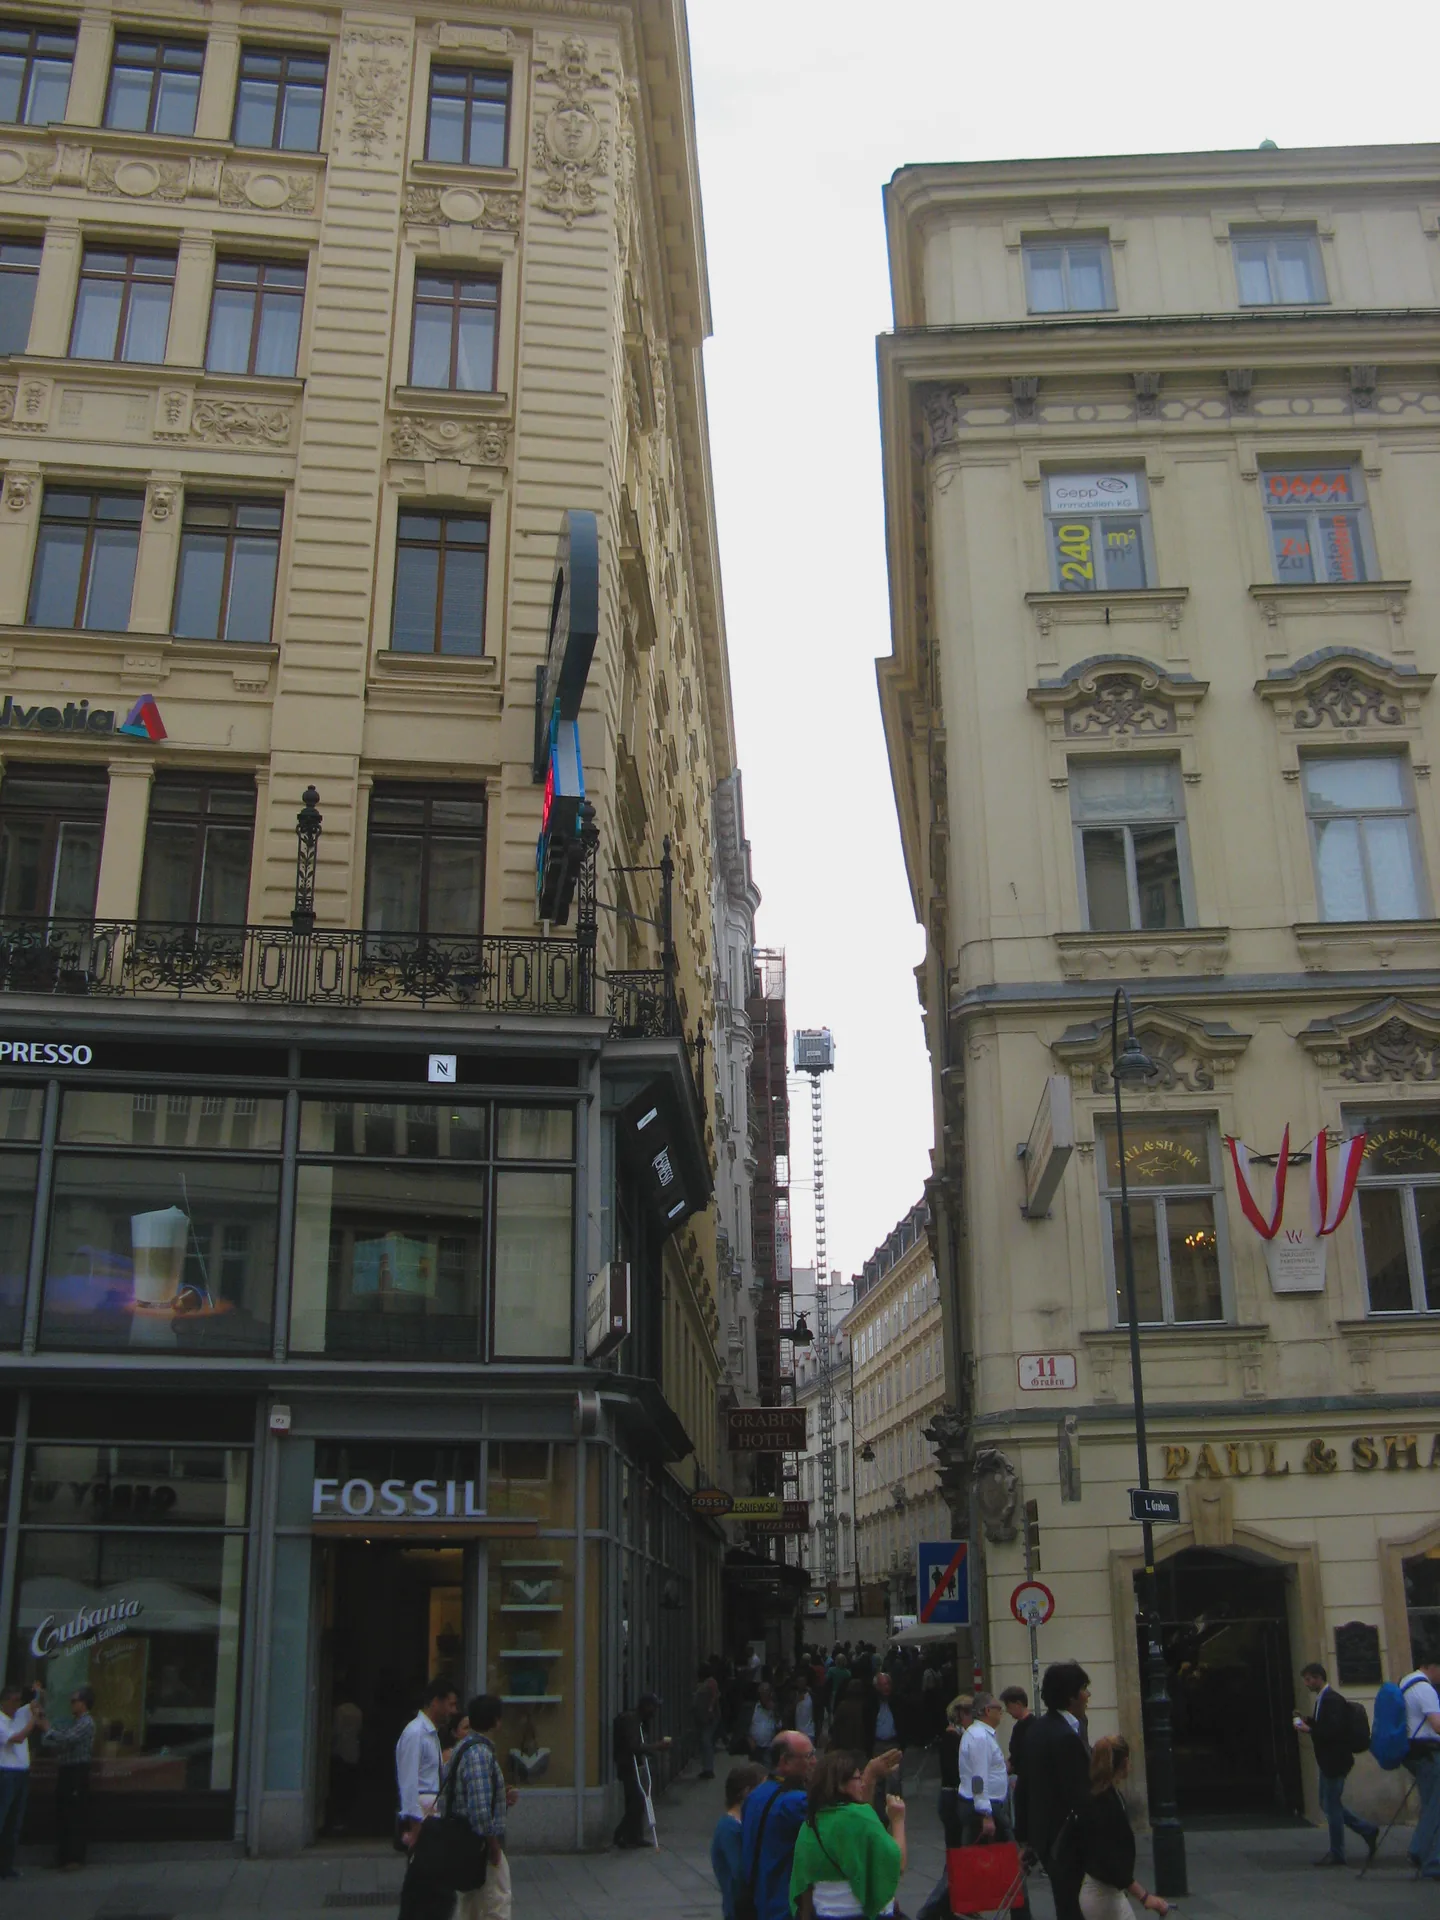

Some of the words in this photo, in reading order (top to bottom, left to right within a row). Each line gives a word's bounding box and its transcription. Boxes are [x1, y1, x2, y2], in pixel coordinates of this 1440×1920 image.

[1056, 487, 1099, 499] Gepp
[1269, 474, 1349, 496] 0664
[1058, 524, 1094, 581] 240
[1281, 538, 1311, 556] Zu
[0, 696, 115, 734] lvetia
[1036, 1357, 1057, 1377] 11
[730, 1413, 804, 1428] GRABEN
[739, 1432, 797, 1447] HOTEL
[1161, 1440, 1289, 1480] PAUL
[1304, 1438, 1338, 1473] &
[312, 1478, 487, 1517] FOSSIL
[691, 1498, 731, 1507] FOSSIL
